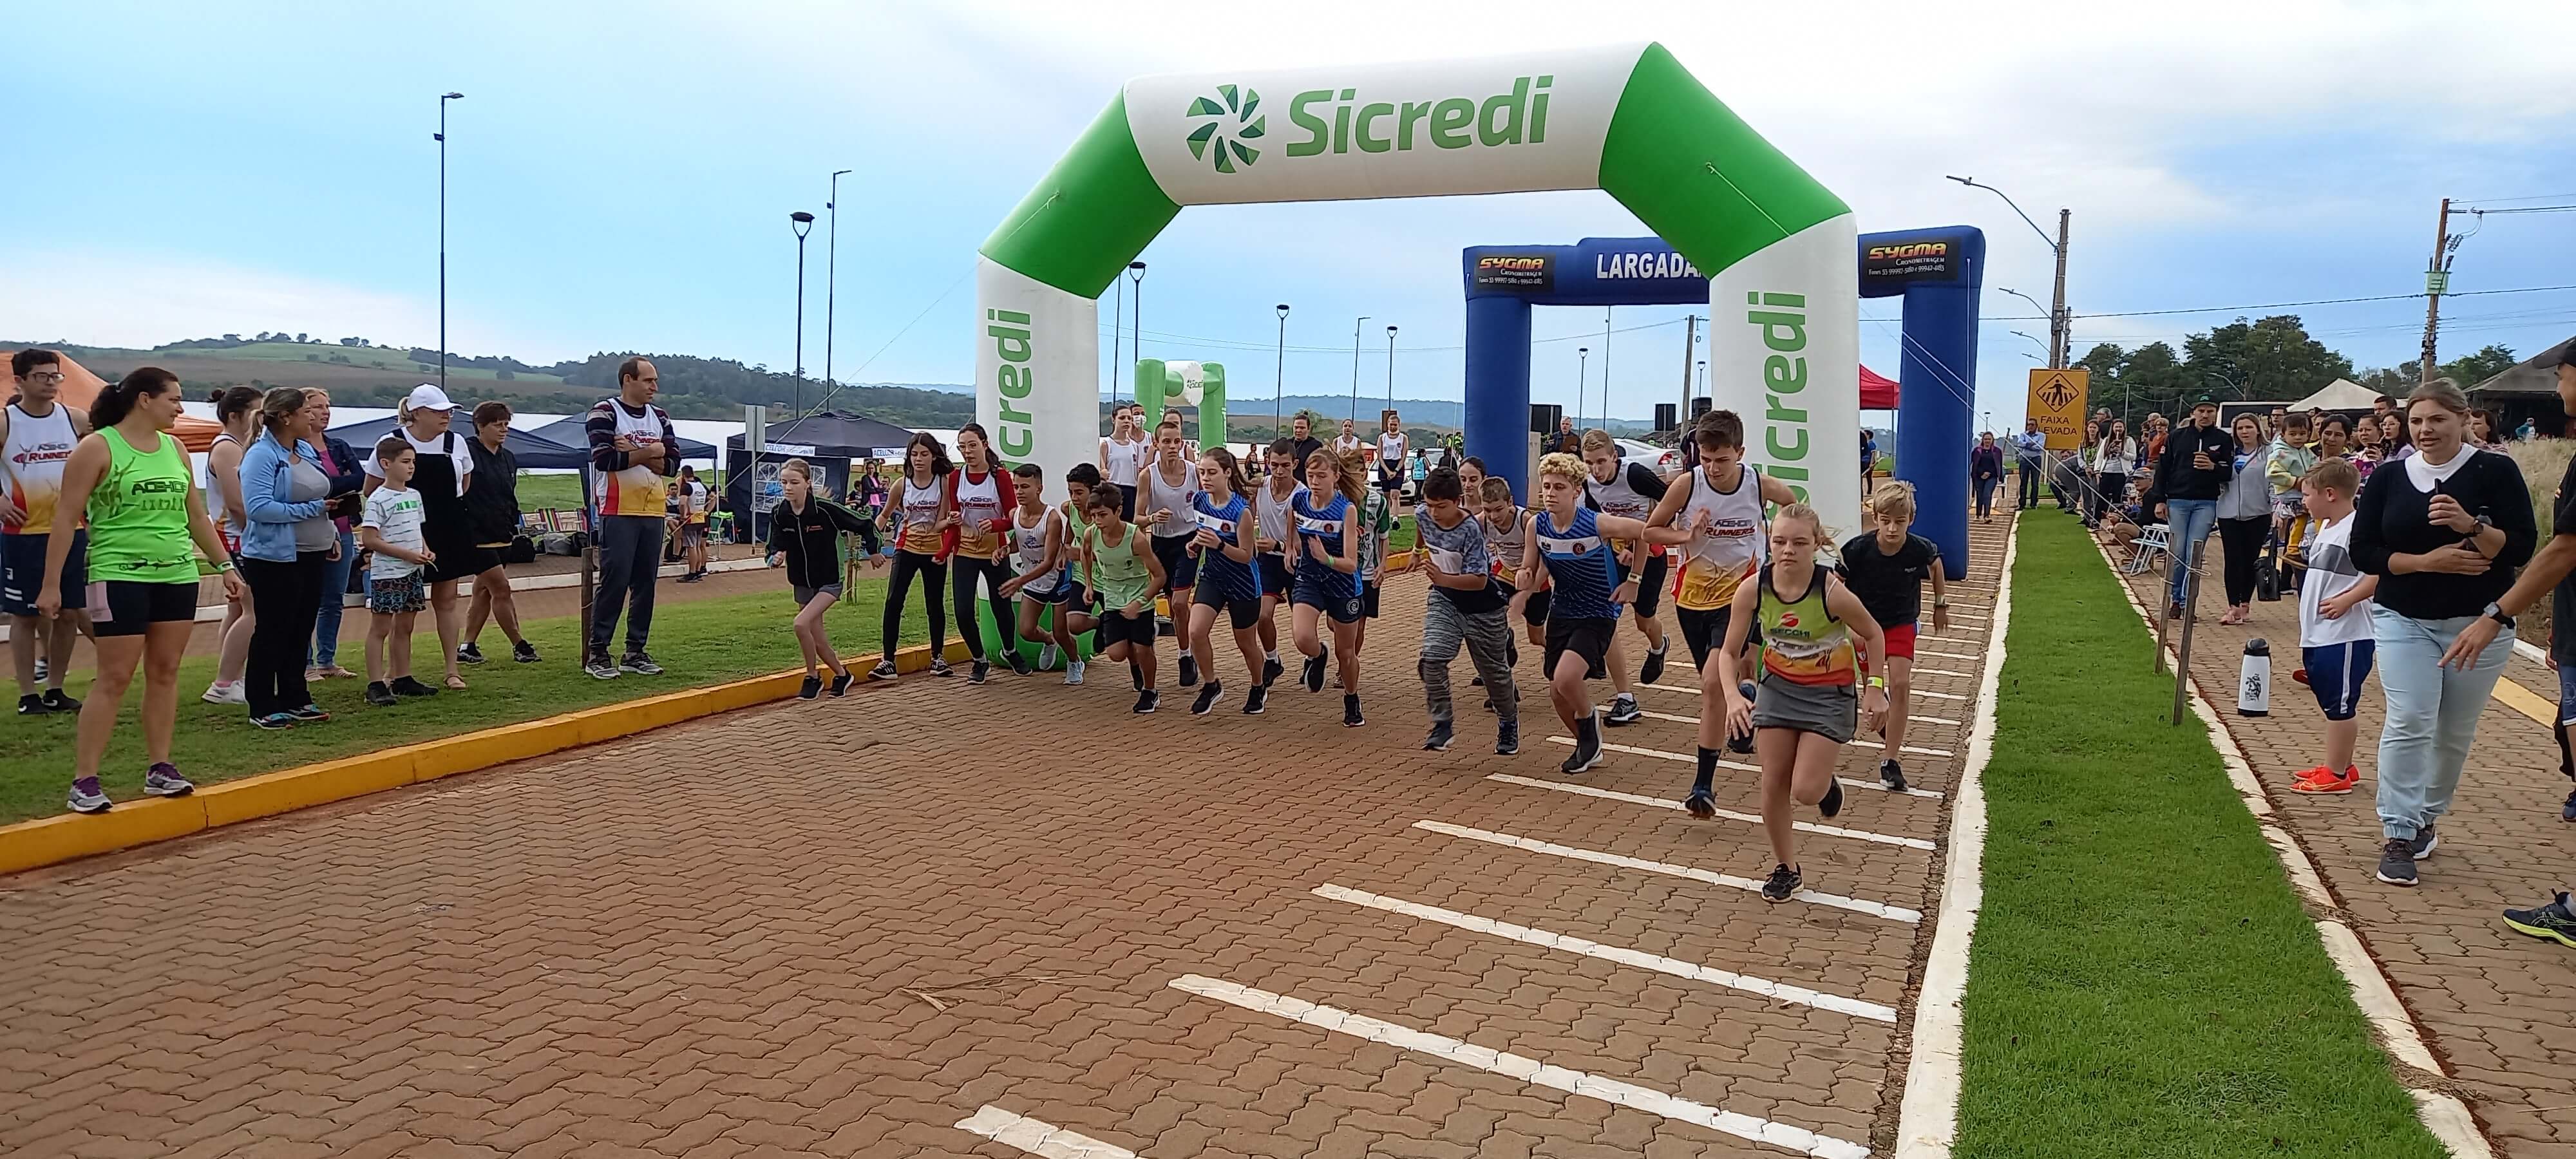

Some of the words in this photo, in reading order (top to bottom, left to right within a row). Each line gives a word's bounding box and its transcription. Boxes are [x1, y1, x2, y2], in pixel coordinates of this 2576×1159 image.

[1286, 75, 1553, 157] Sicredi
[1868, 243, 1947, 259] SYGMA
[1479, 258, 1544, 269] SYGMA
[987, 308, 1033, 474] credi
[2040, 415, 2069, 424] FAIXA
[1704, 525, 1755, 536] RUNNERS
